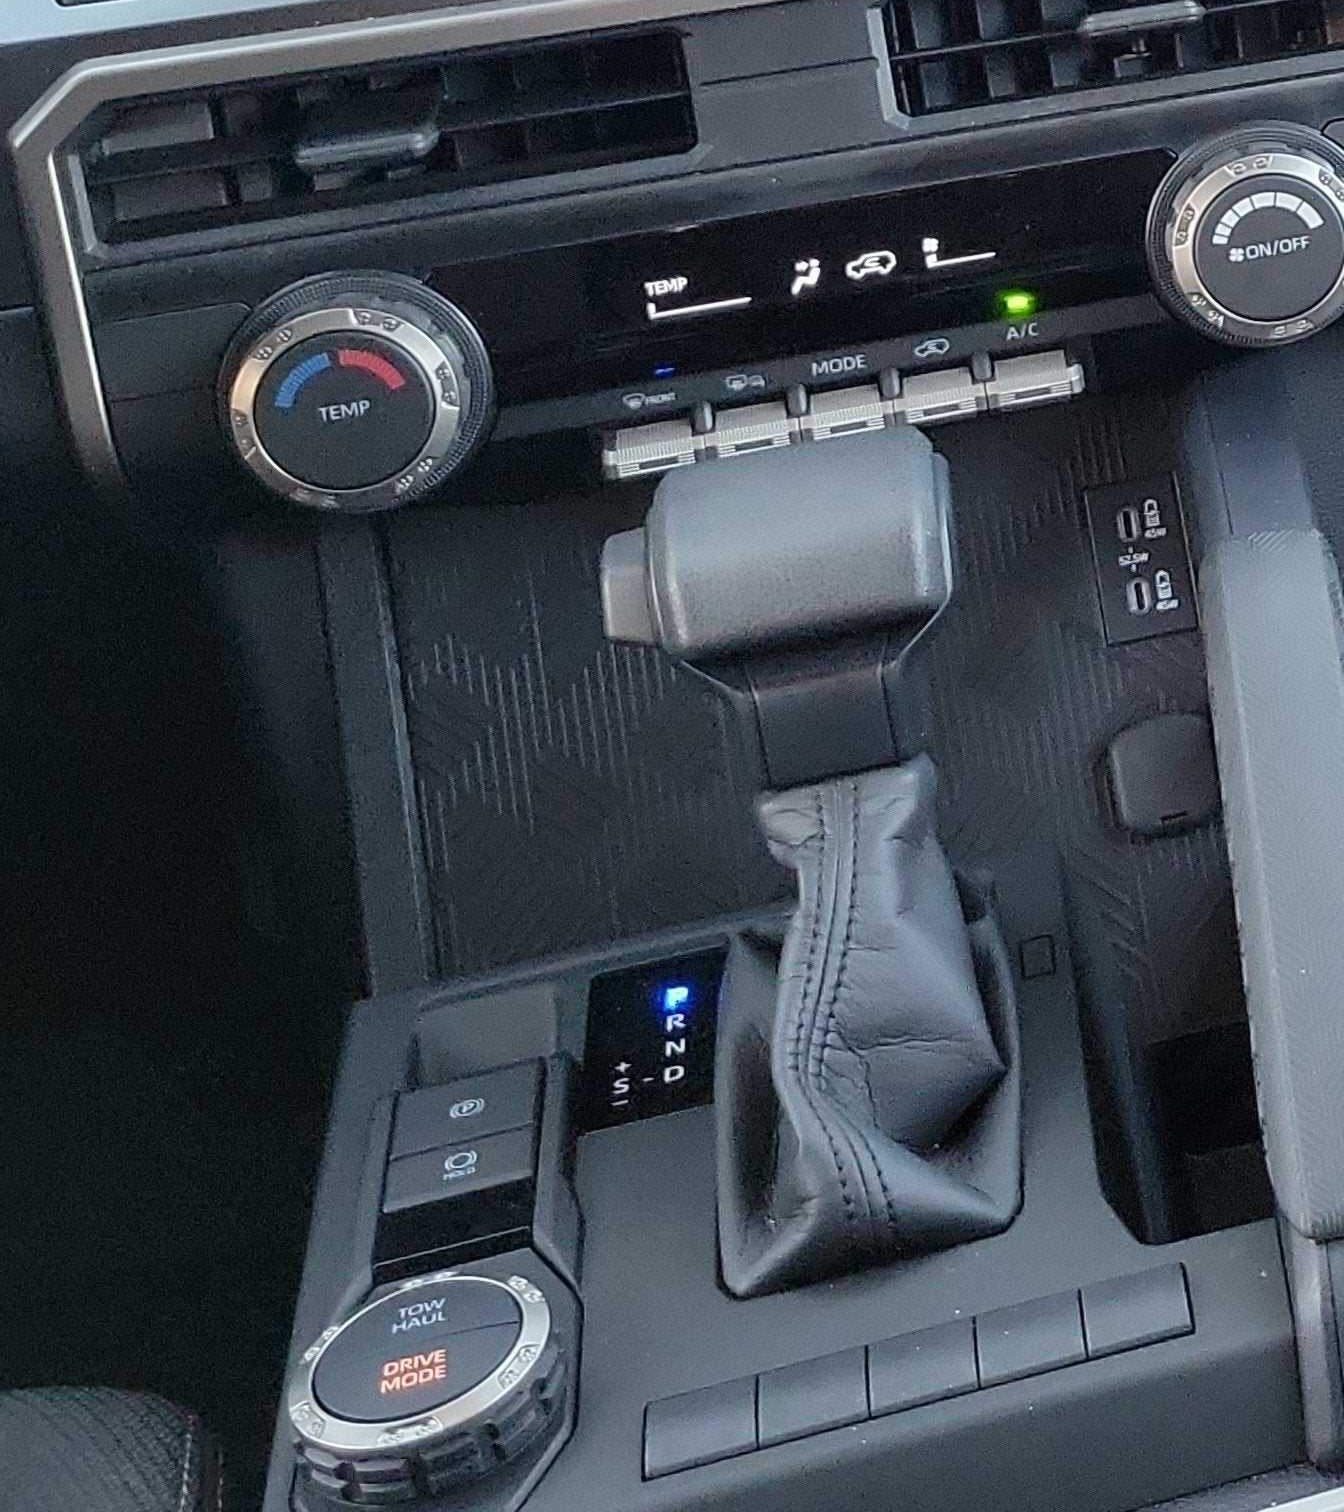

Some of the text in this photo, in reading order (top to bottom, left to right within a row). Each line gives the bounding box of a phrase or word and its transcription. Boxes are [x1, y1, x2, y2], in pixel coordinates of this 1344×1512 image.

[1245, 236, 1311, 259] ON/OFF
[645, 277, 688, 296] TEMP
[1006, 323, 1039, 340] A/C
[811, 354, 868, 376] MODE
[318, 400, 370, 422] TEMP
[665, 987, 689, 1010] P
[666, 1013, 686, 1032] R
[665, 1038, 686, 1057] N
[663, 1065, 685, 1083] D
[612, 1077, 629, 1094] S
[399, 1298, 446, 1319] TOW
[392, 1311, 446, 1334] HAUL
[383, 1349, 446, 1377] DRIVE
[380, 1365, 446, 1394] MODE
